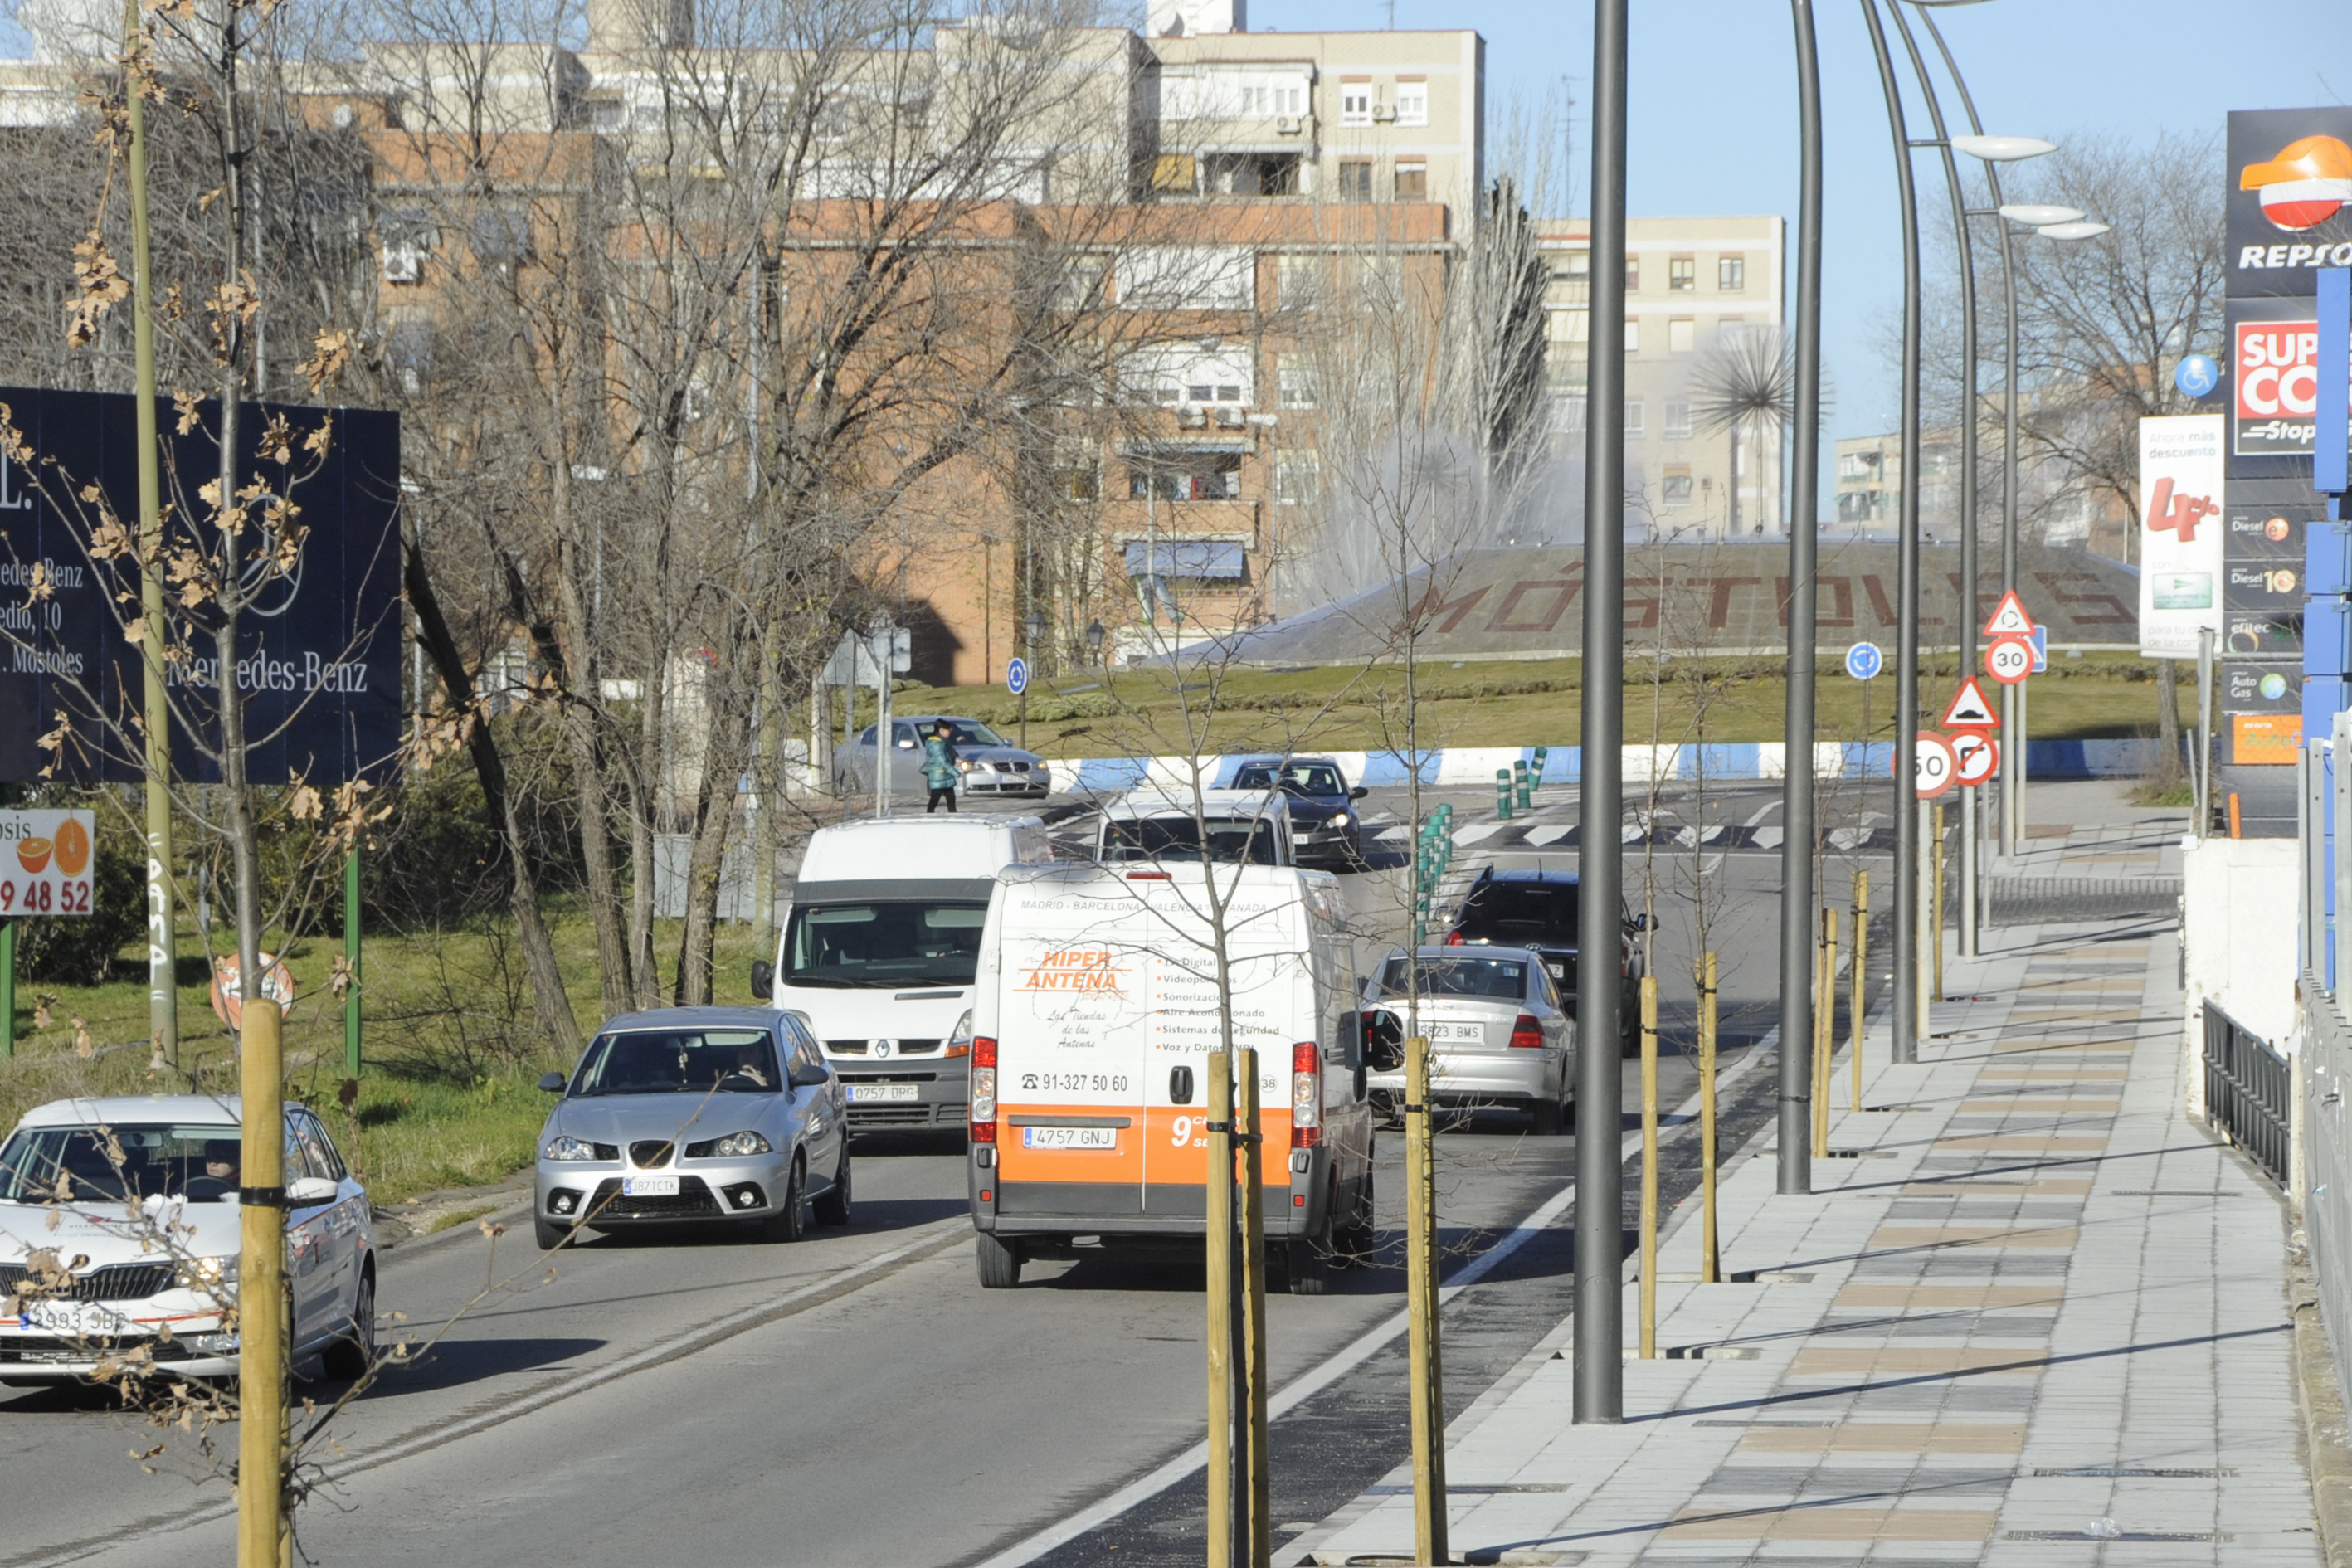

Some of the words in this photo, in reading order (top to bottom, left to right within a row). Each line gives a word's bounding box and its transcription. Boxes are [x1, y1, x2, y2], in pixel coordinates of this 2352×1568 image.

[2242, 334, 2318, 368] SUP
[2242, 365, 2317, 414] CO
[2149, 431, 2184, 443] Ahora
[2189, 430, 2216, 442] más
[2266, 421, 2317, 445] Stop
[2149, 446, 2216, 459] descuento
[2147, 477, 2219, 542] 4%
[2233, 520, 2263, 532] Diesel
[2231, 572, 2262, 584] Diesel
[43, 601, 61, 631] 10
[12, 643, 83, 674] Móstoles
[1997, 652, 2023, 667] 30
[168, 646, 368, 693] Meredes-Benz
[2231, 676, 2257, 687] Auto
[2230, 687, 2252, 698] Gas
[23, 881, 51, 911] 48
[61, 881, 89, 912] 52
[1021, 900, 1064, 910] MADRID
[1073, 901, 1140, 911] BARCELONA
[1151, 903, 1203, 912] VALENCIA
[1225, 903, 1268, 913] ANADA
[1042, 952, 1112, 967] HIPER
[1025, 972, 1117, 988] ANTENA
[1047, 1010, 1065, 1021] Las
[1070, 1009, 1106, 1021] Tiendas
[1163, 1009, 1184, 1017] Aire
[1188, 1009, 1265, 1017] Acondonado
[1062, 1025, 1072, 1034] de
[1075, 1025, 1090, 1034] las
[1162, 1025, 1208, 1035] Sistemas
[1232, 1026, 1280, 1037] eguridad
[1457, 1026, 1478, 1038] BMS
[1057, 1037, 1095, 1048] Antenas
[1185, 1045, 1190, 1054] y
[1194, 1043, 1223, 1052] Datos
[1043, 1074, 1088, 1089] 91-327
[1093, 1075, 1108, 1091] 50
[1113, 1075, 1127, 1091] 60
[1261, 1079, 1276, 1088] 38
[855, 1088, 885, 1099] 0757
[1037, 1130, 1074, 1144] 4757
[1081, 1130, 1110, 1145] GNJ
